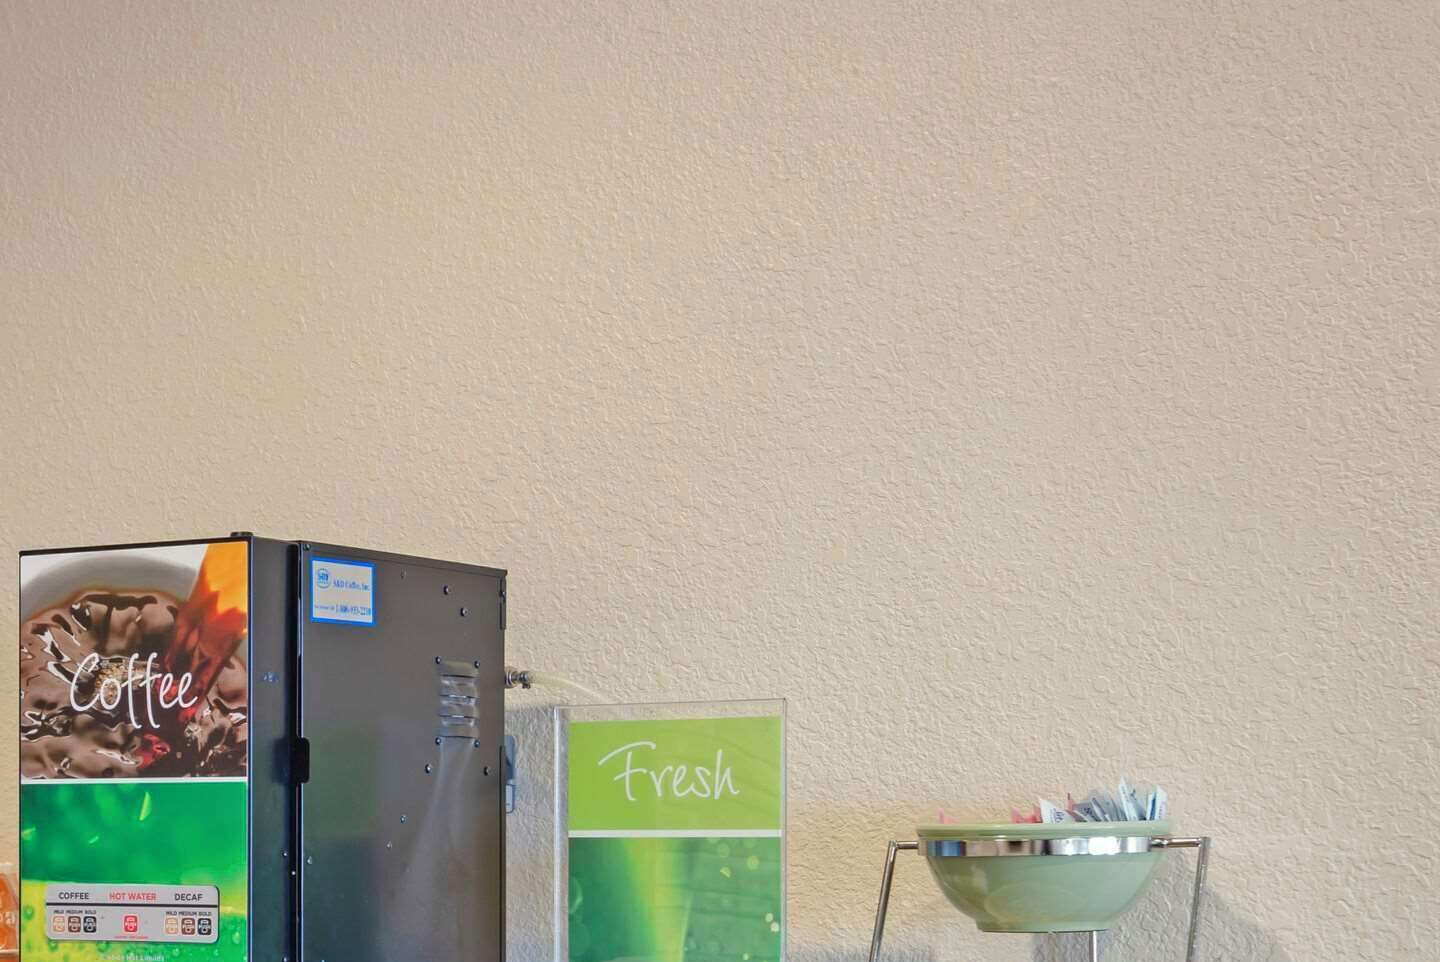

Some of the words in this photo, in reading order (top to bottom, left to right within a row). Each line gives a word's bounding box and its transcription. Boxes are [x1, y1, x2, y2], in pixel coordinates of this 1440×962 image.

[69, 651, 199, 729] Coffee
[597, 739, 740, 801] Fresh
[58, 891, 90, 900] COFFEE
[109, 892, 127, 901] HOT
[128, 892, 157, 901] WATER
[174, 893, 203, 902] DECAF
